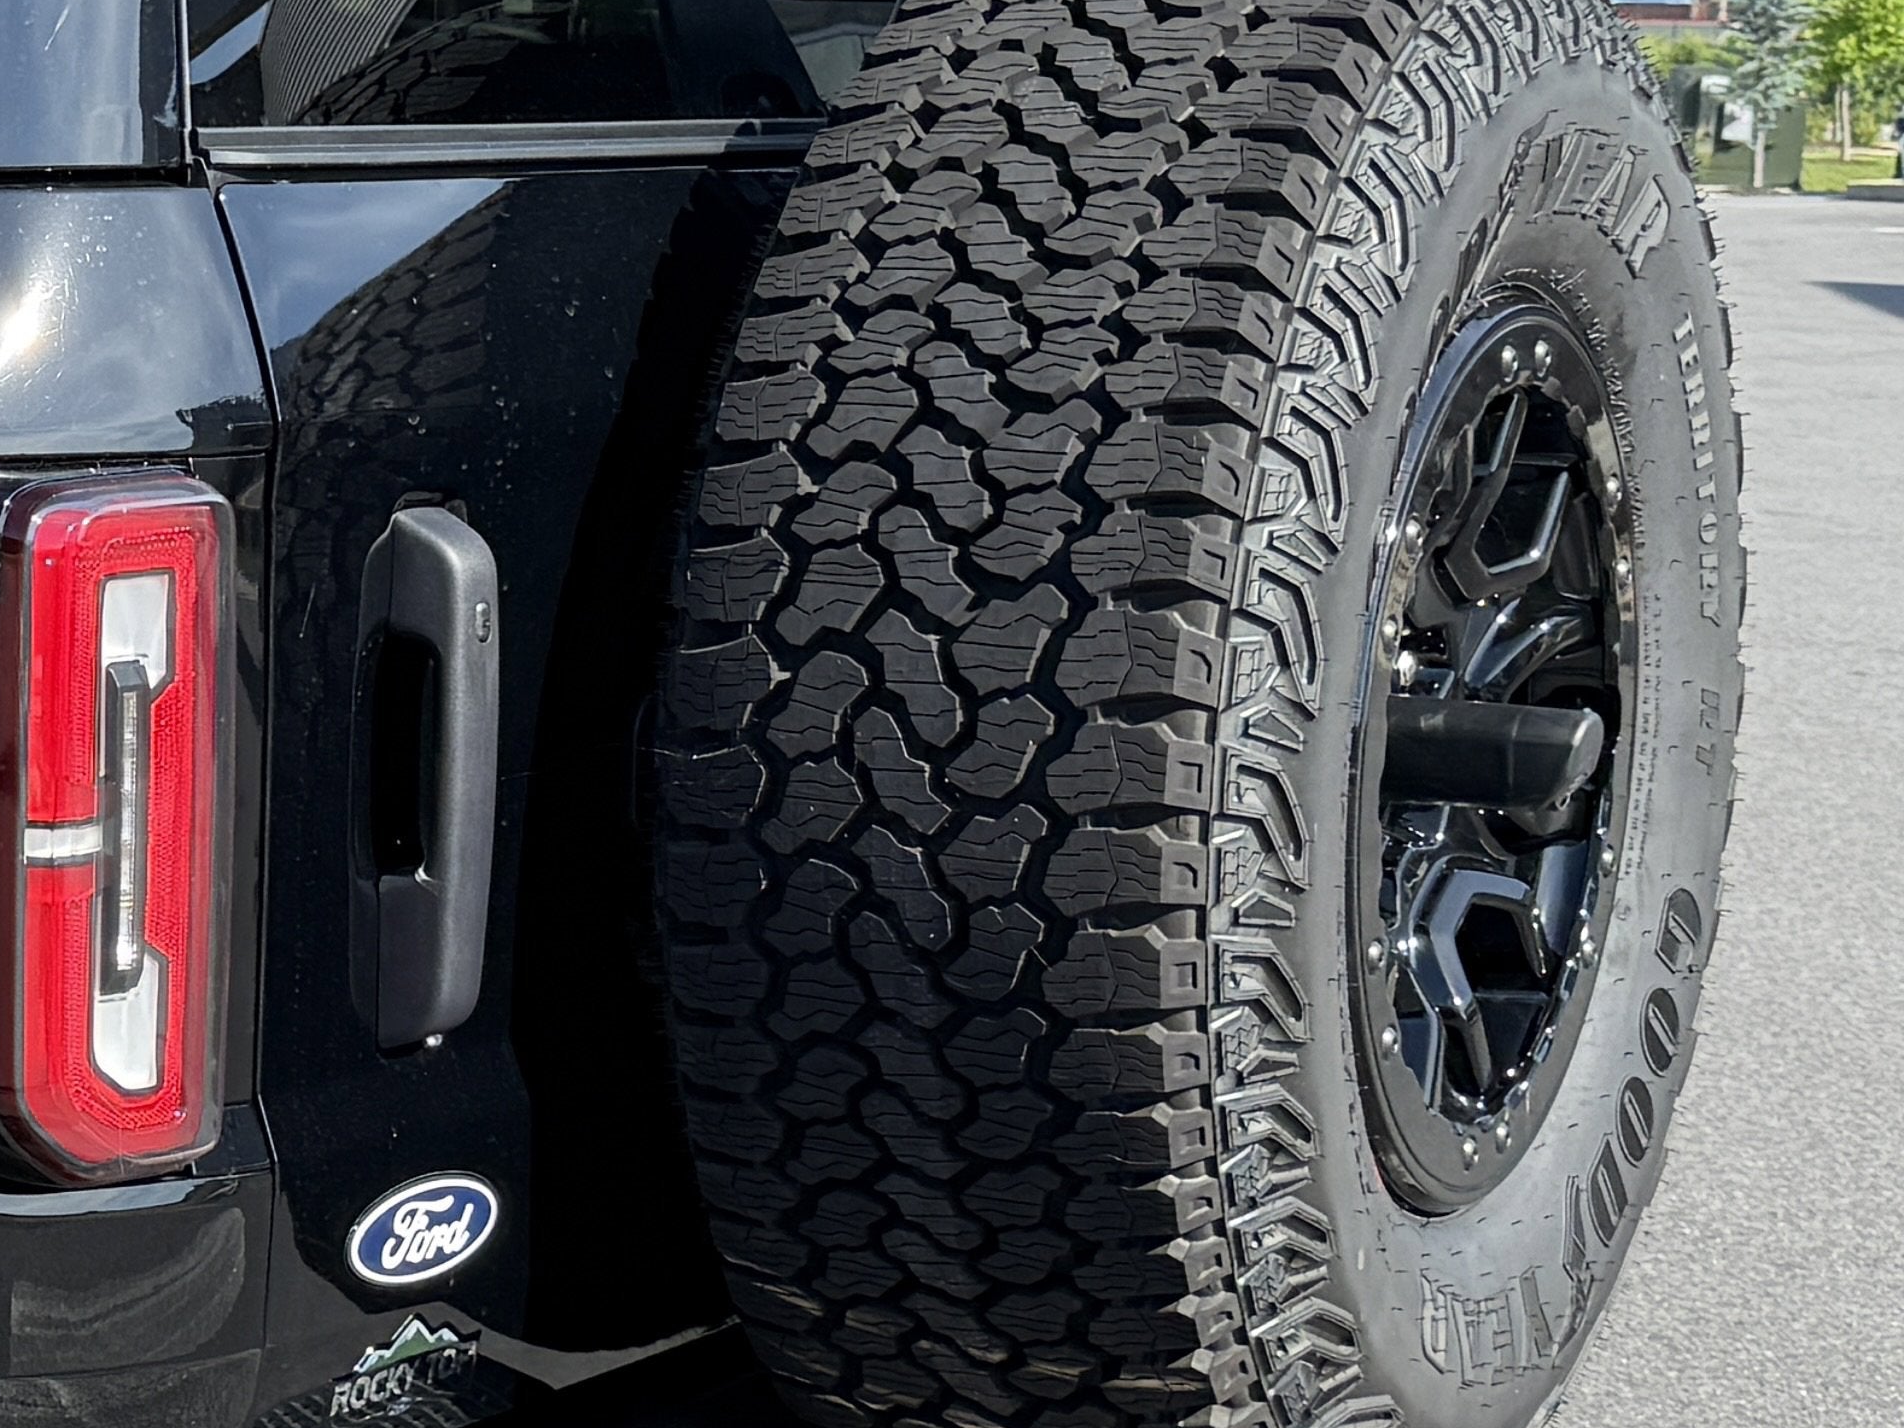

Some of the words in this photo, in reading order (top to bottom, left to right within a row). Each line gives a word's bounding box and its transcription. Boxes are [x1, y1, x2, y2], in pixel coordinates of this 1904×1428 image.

[1673, 311, 1721, 628] TERRITORY
[380, 1194, 475, 1270] Ford
[329, 1359, 419, 1417] ROCKY
